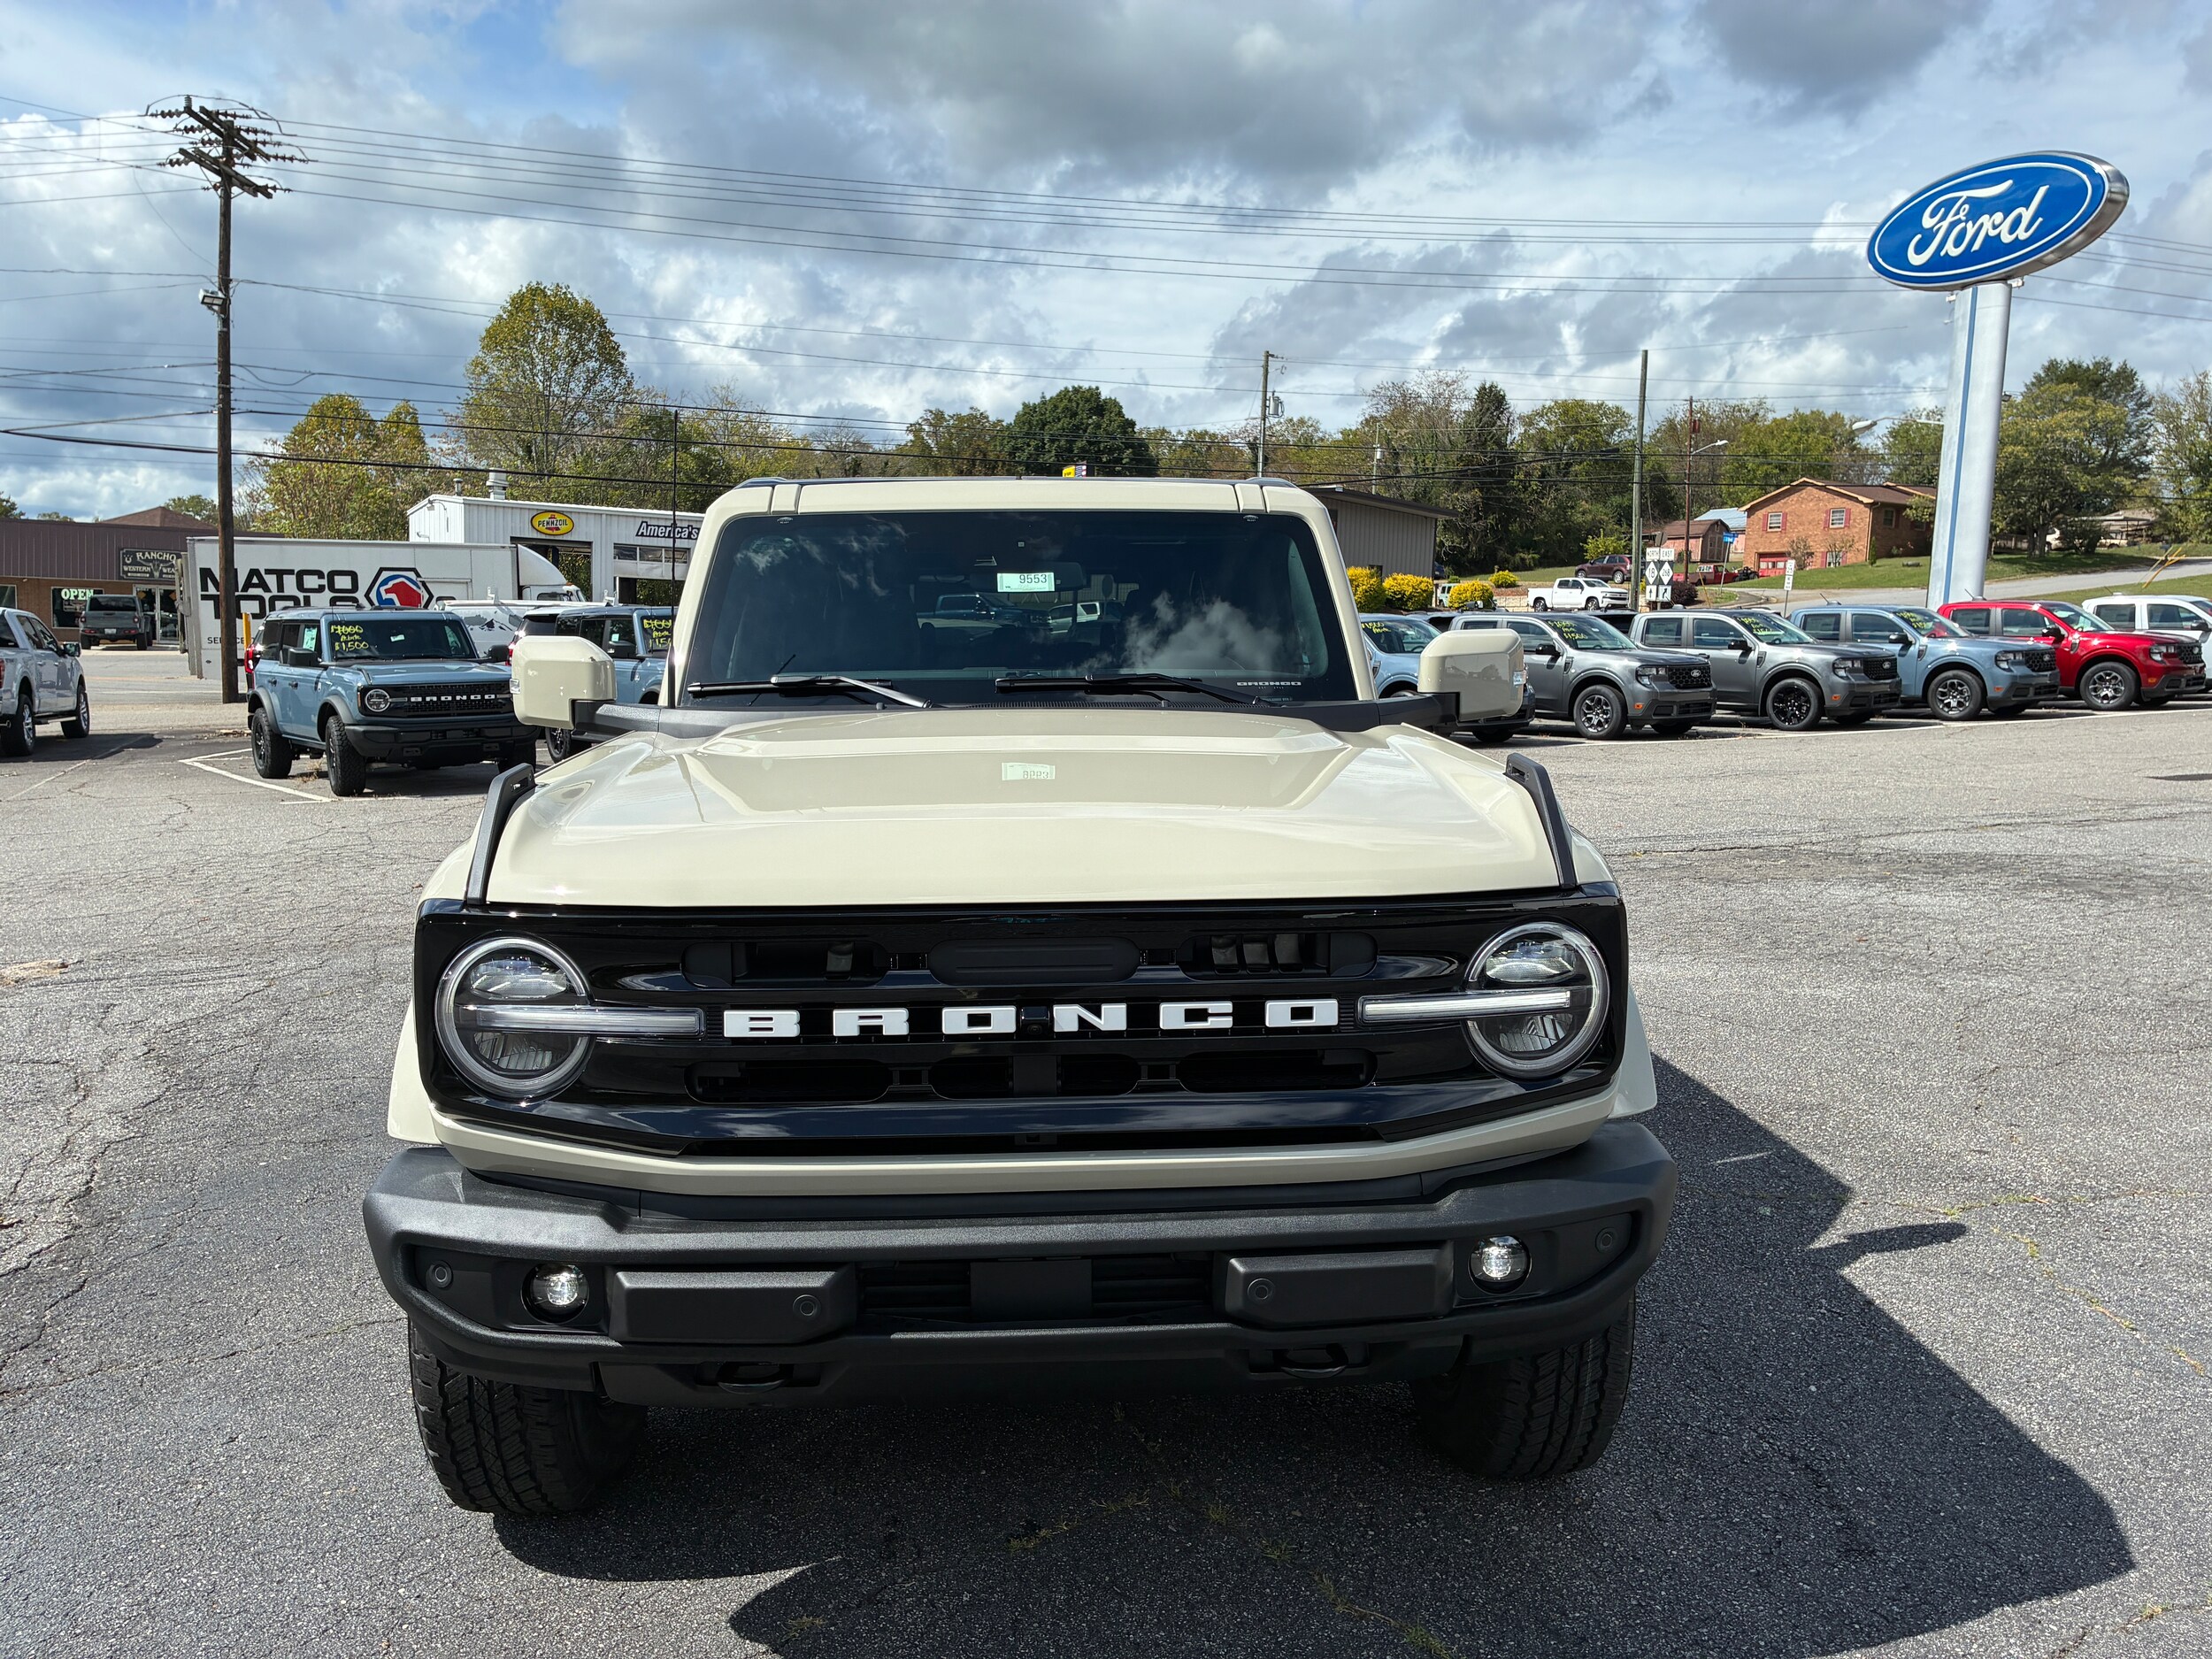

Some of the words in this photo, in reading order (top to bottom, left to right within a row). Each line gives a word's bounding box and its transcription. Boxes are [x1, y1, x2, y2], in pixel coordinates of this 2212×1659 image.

[1907, 180, 2049, 265] Ford
[638, 522, 699, 539] America's
[135, 551, 177, 562] RANCHO
[1648, 567, 1655, 578] 18
[199, 567, 359, 594] MATCO
[1019, 573, 1048, 584] 9553
[61, 588, 94, 600] OPEN
[334, 641, 369, 651] $1,500
[410, 694, 496, 703] BRONCO
[723, 999, 1339, 1038] BRONCO
